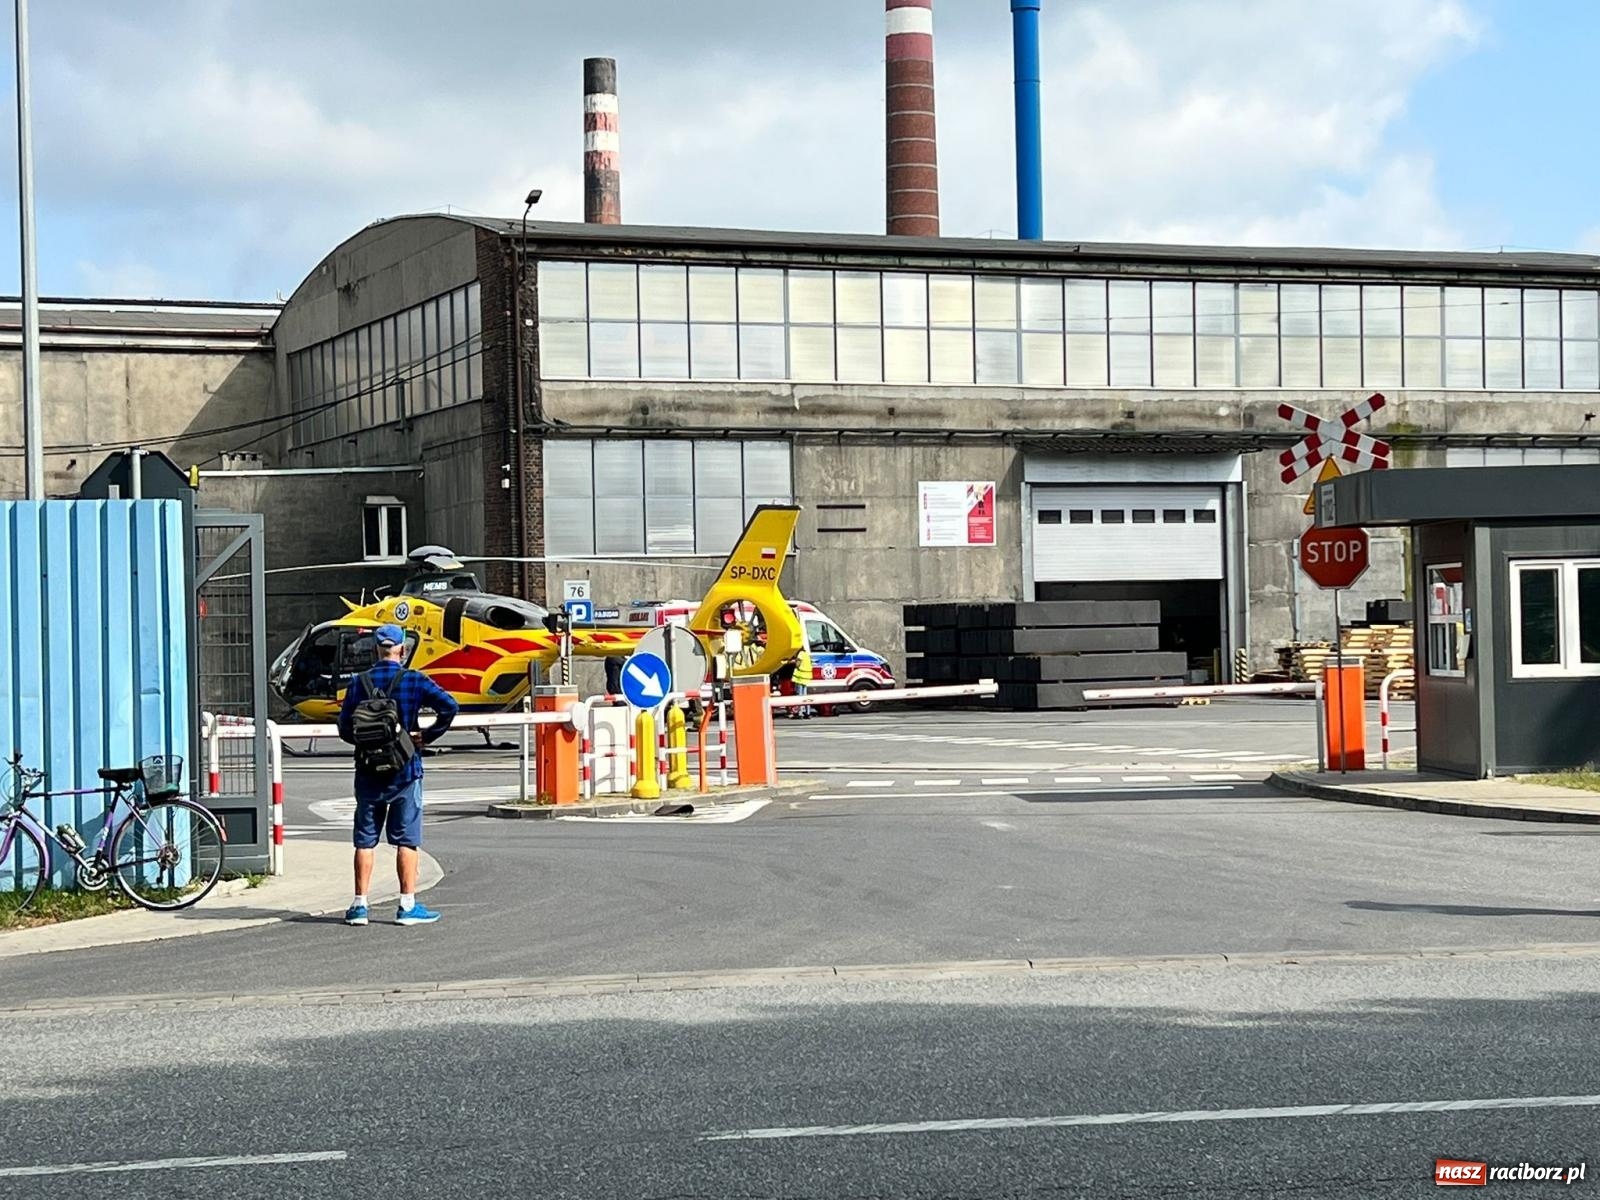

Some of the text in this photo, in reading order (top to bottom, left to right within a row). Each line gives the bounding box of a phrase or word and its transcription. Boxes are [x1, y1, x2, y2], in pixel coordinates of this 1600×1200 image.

[1306, 540, 1362, 563] STOP
[731, 565, 776, 580] SP-DXC
[570, 586, 585, 598] 76
[571, 604, 587, 623] P
